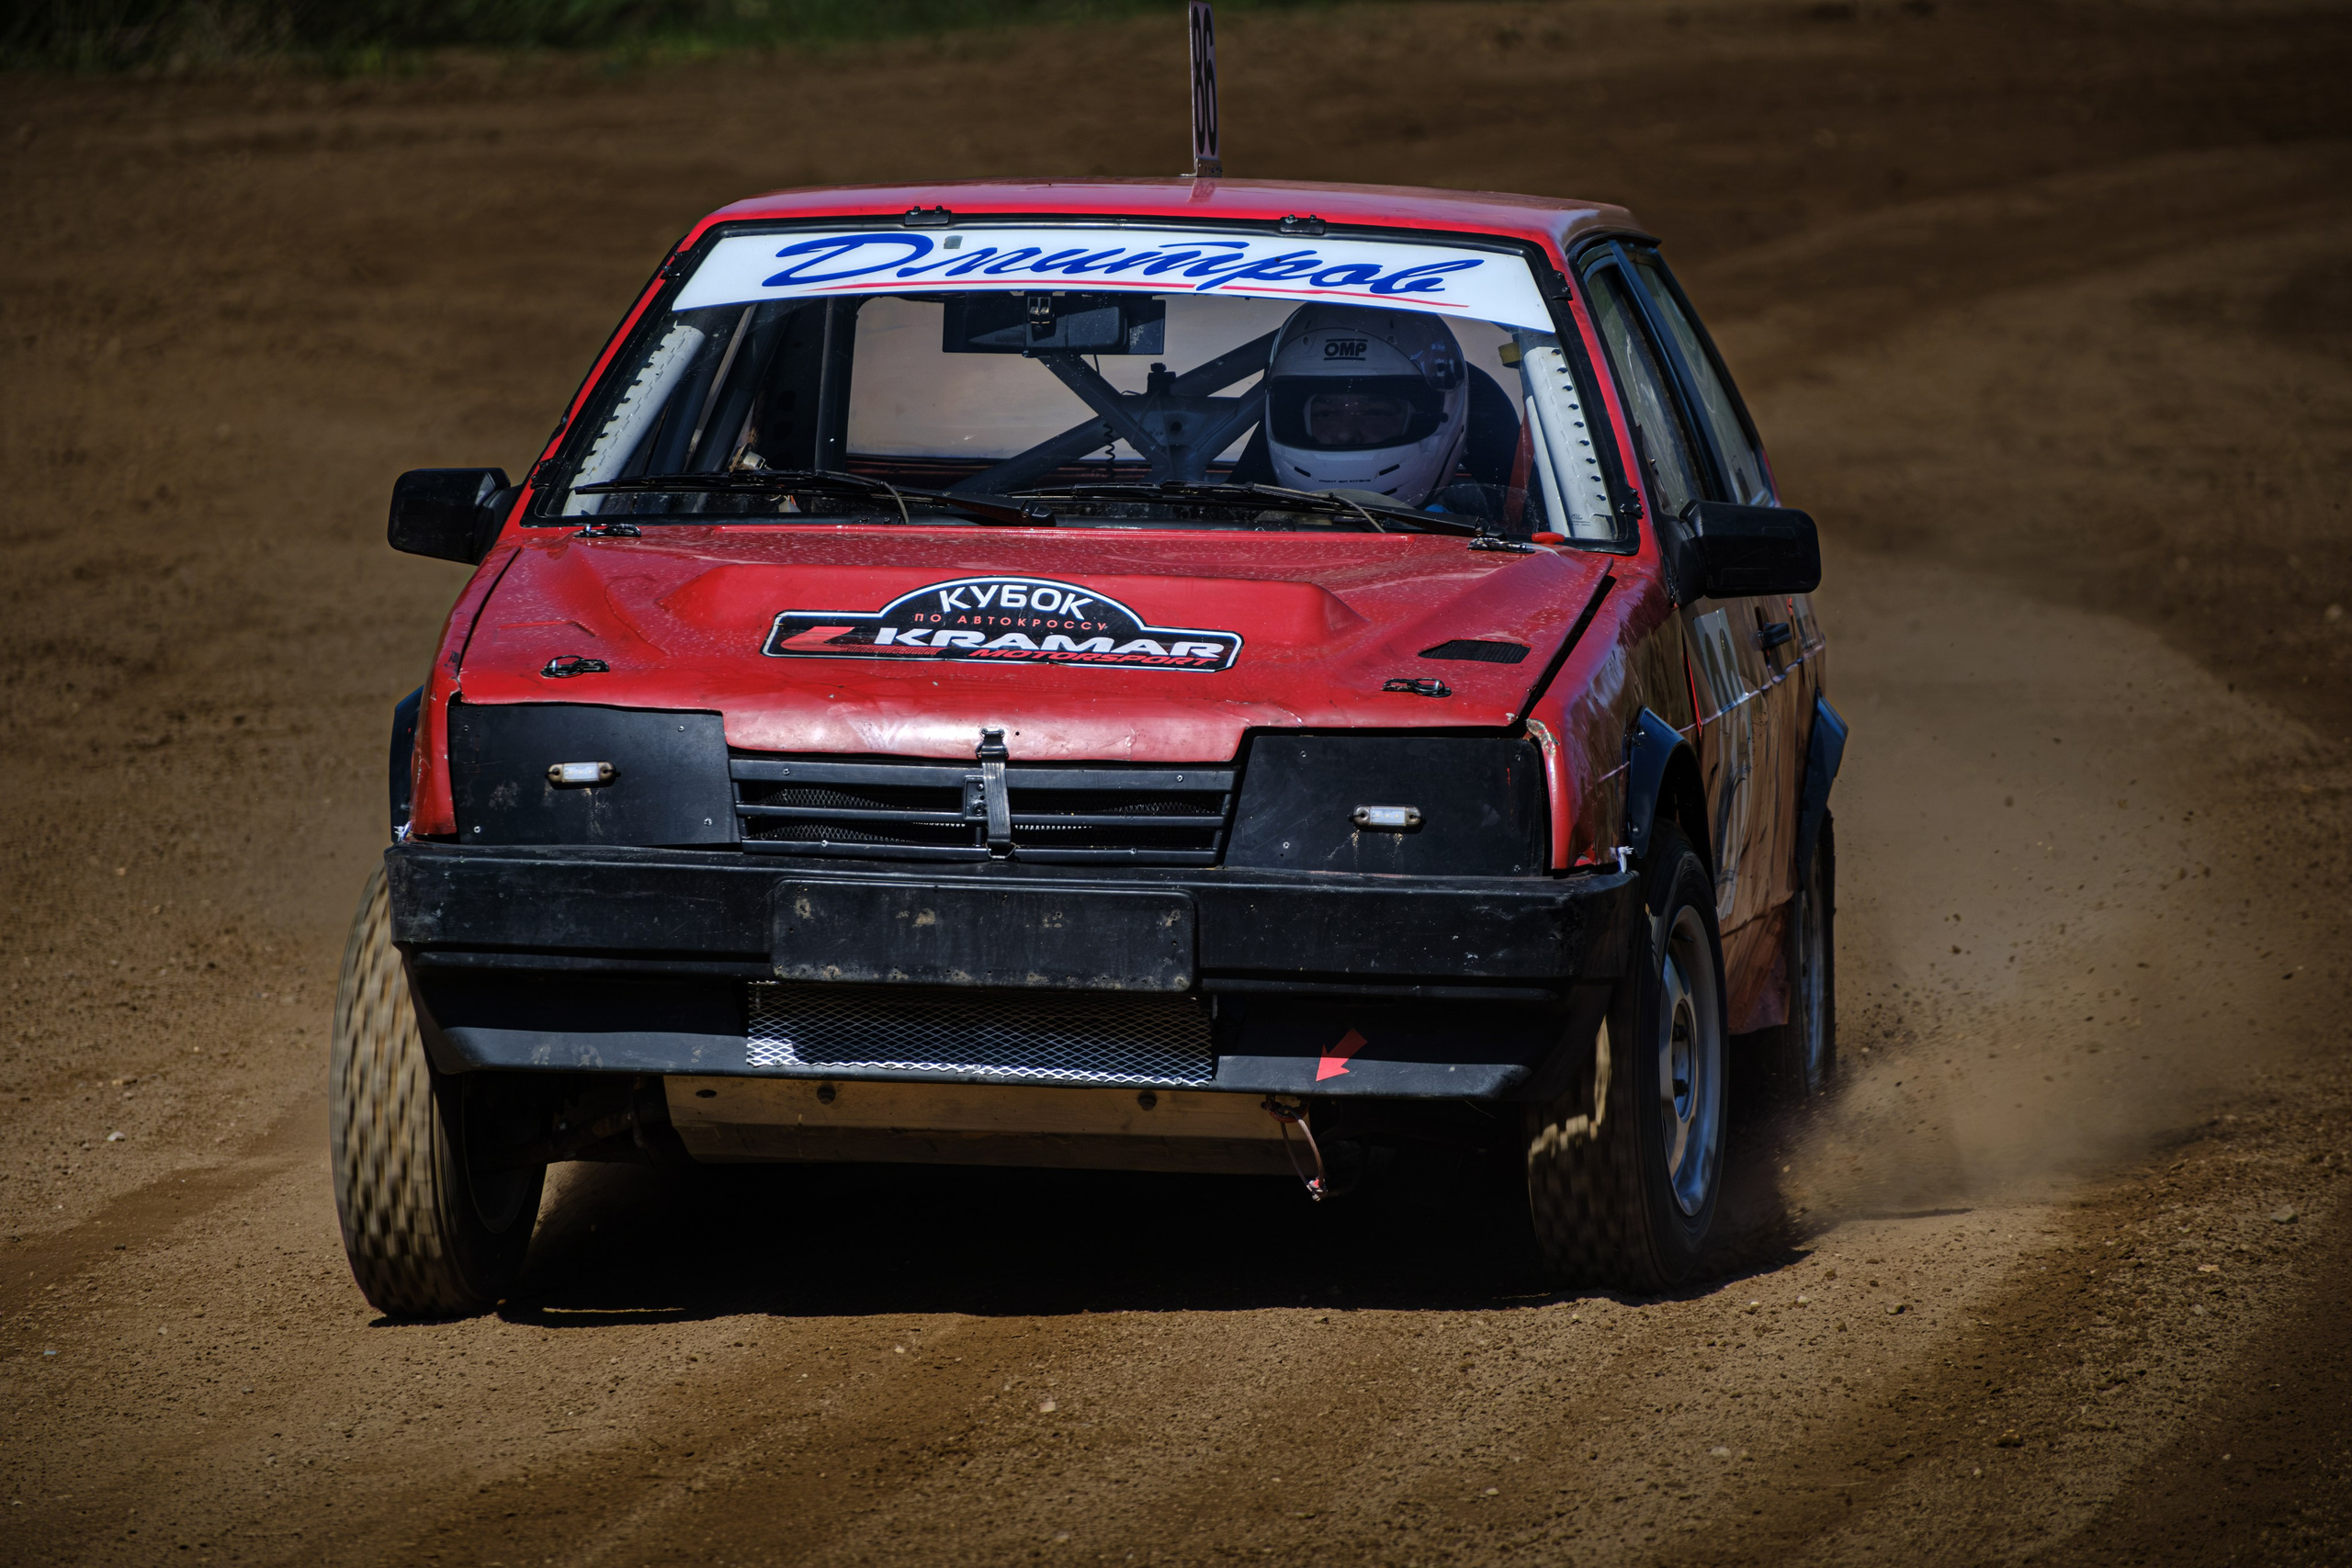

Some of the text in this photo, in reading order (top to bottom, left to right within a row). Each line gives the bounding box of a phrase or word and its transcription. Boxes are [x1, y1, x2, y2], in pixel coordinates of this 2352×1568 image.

[1193, 6, 1216, 155] 86
[1324, 342, 1367, 356] OMP
[939, 584, 1094, 620] КУБОК
[914, 613, 1107, 631] ПО АВТОКРОССУ
[874, 626, 1224, 659] KRAMAR
[968, 649, 1217, 667] MOTORSPORT
